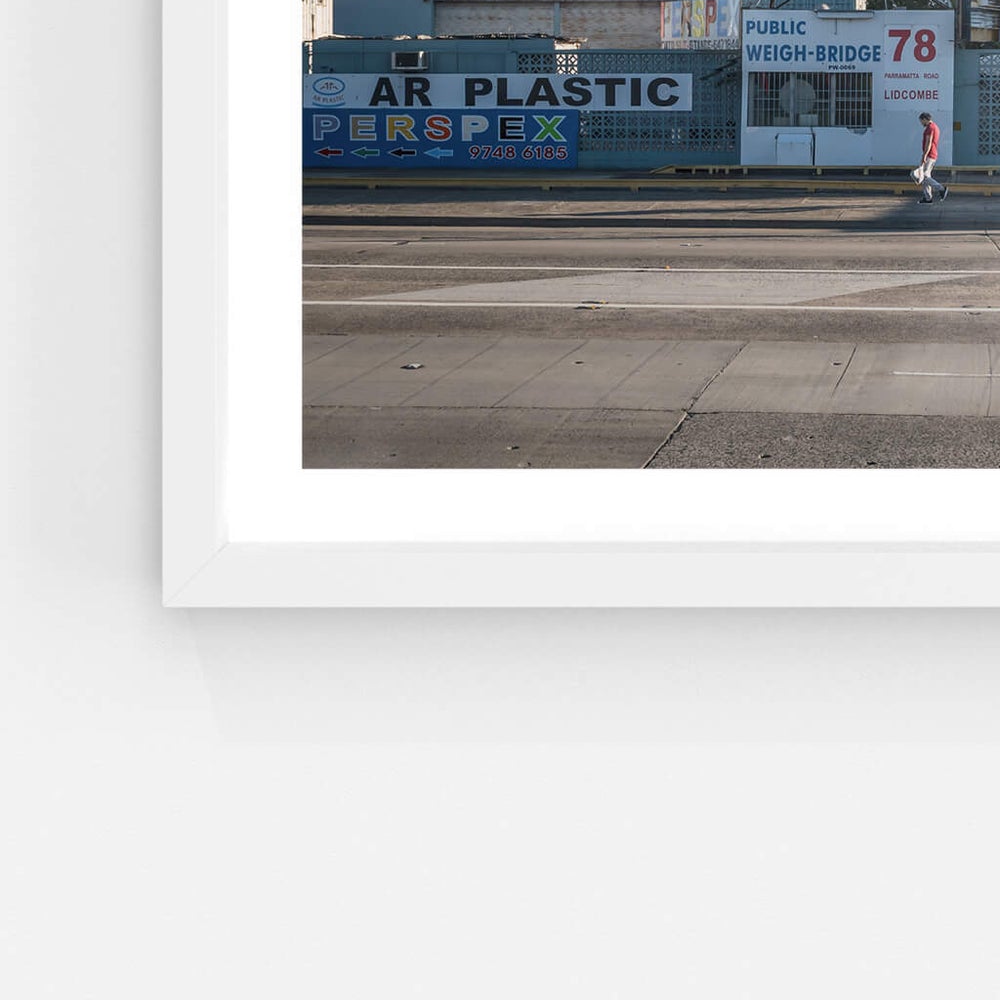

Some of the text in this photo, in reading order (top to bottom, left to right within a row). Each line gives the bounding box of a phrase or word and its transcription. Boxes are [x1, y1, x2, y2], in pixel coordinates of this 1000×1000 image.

[746, 20, 806, 35] PUBLIC
[746, 44, 881, 62] WEIGH-BRIDGE
[888, 28, 937, 63] 78
[368, 77, 680, 107] AR PLASTIC
[884, 90, 939, 100] LIDCOMBE
[312, 114, 567, 142] PERSPEX
[469, 145, 568, 160] 9748 6185
